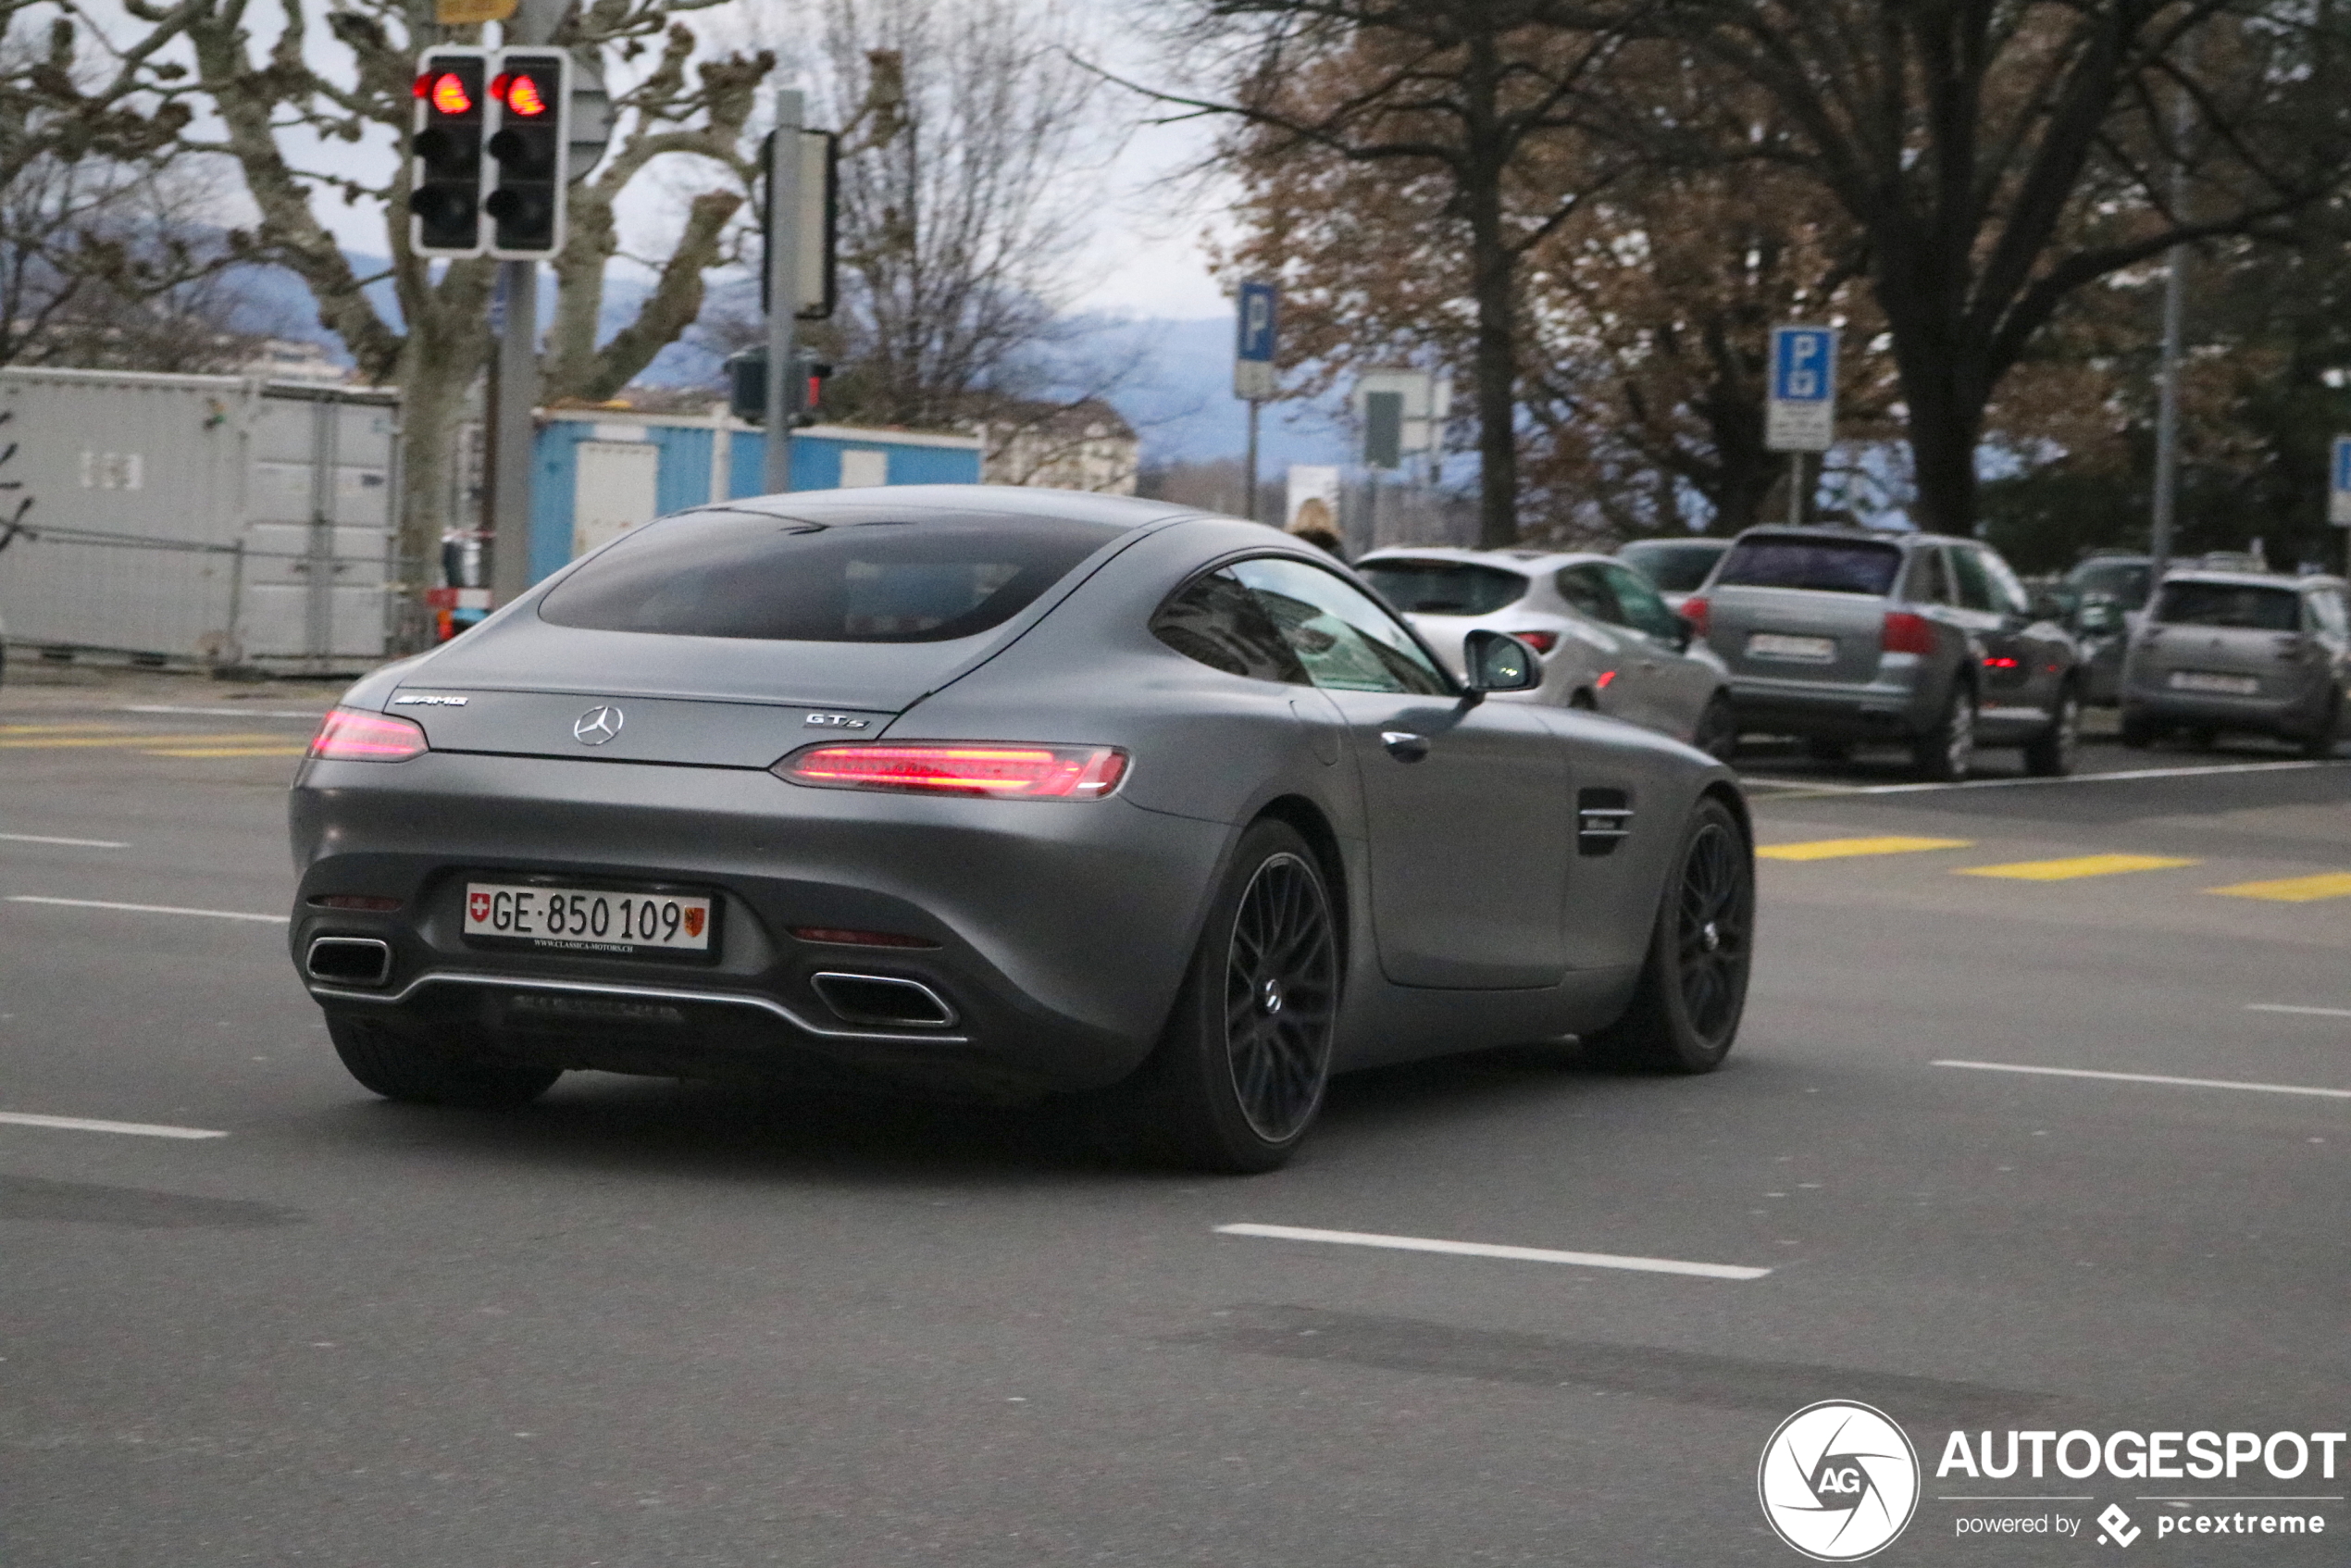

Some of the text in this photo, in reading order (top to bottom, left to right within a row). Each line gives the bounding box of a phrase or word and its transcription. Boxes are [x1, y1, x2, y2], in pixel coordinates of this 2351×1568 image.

[1247, 293, 1269, 351] P
[1792, 334, 1817, 371] P
[413, 695, 468, 706] AMG
[534, 939, 634, 953] WWW.CLASSICA-MOTORS.CH
